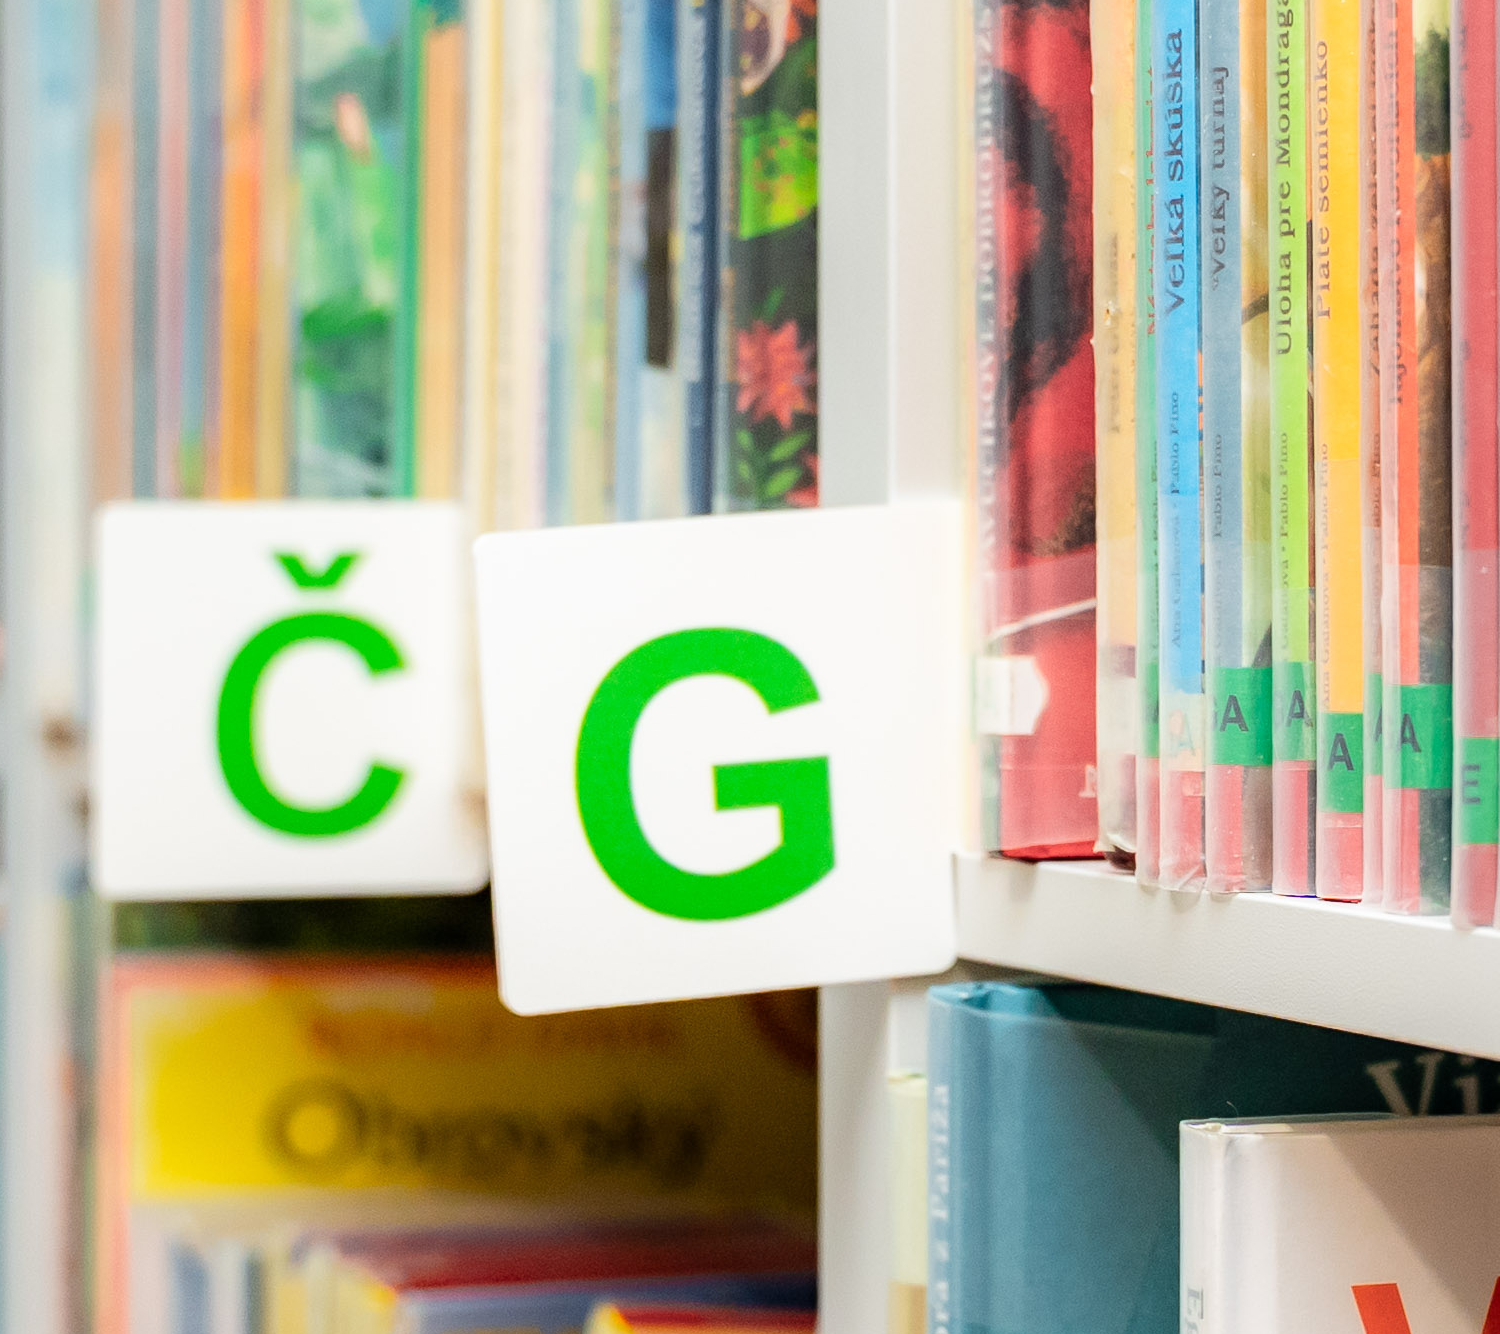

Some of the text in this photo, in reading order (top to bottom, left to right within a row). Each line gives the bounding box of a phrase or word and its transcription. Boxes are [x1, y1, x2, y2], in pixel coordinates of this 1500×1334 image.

[1159, 29, 1186, 313] Veľká skúška
[1276, 178, 1296, 237] pre
[1313, 42, 1331, 211] semienko
[217, 551, 410, 840] Č
[576, 627, 837, 922] G
[932, 1240, 949, 1262] z
